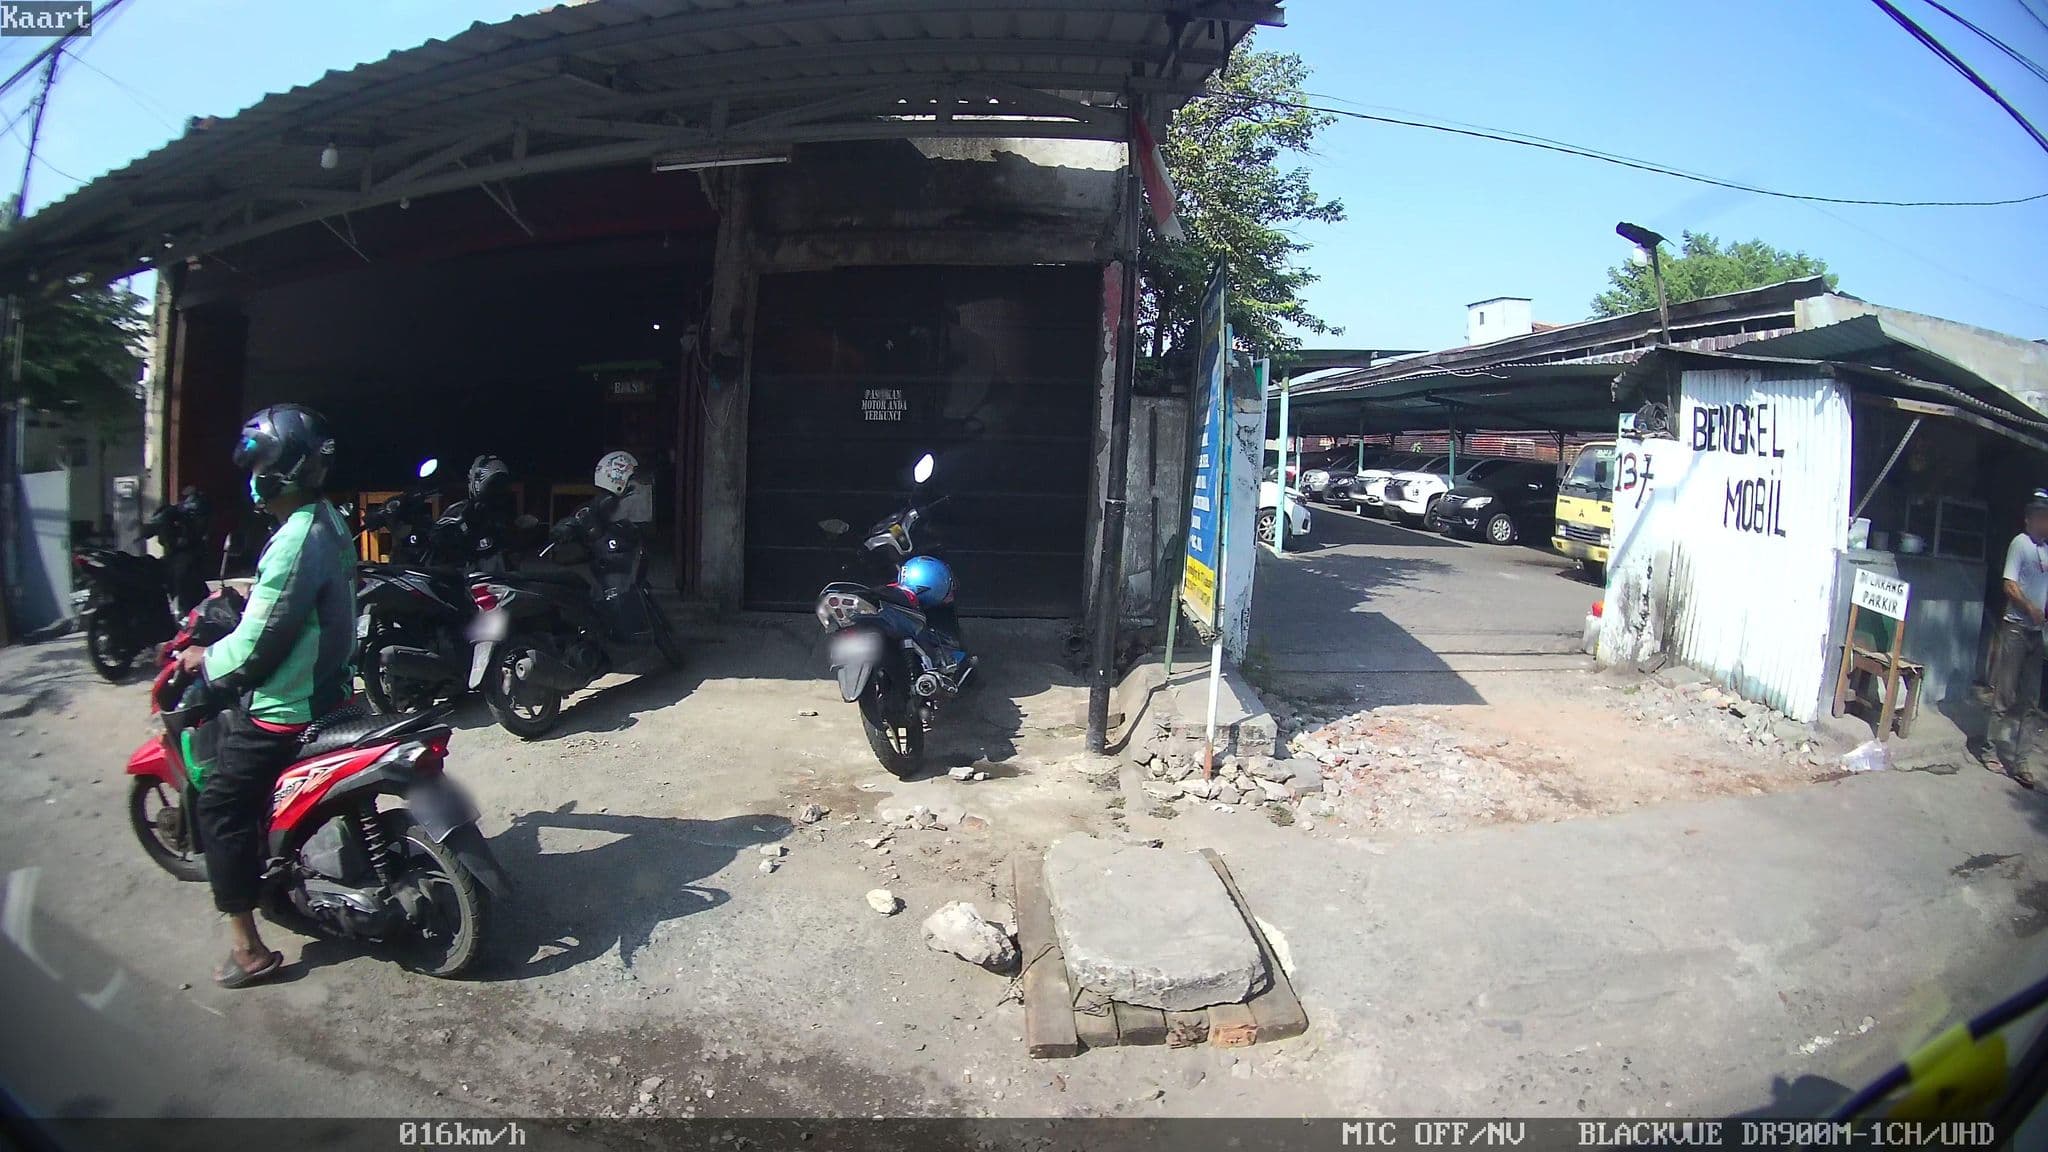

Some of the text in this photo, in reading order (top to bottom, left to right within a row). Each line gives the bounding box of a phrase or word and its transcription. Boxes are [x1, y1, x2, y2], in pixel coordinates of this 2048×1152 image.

[861, 399, 907, 411] MOTOR ANDA
[865, 410, 901, 421] TERKUNCI
[1693, 403, 1785, 458] BENGKEL
[1614, 451, 1655, 510] 137
[1862, 590, 1899, 614] PARKIR
